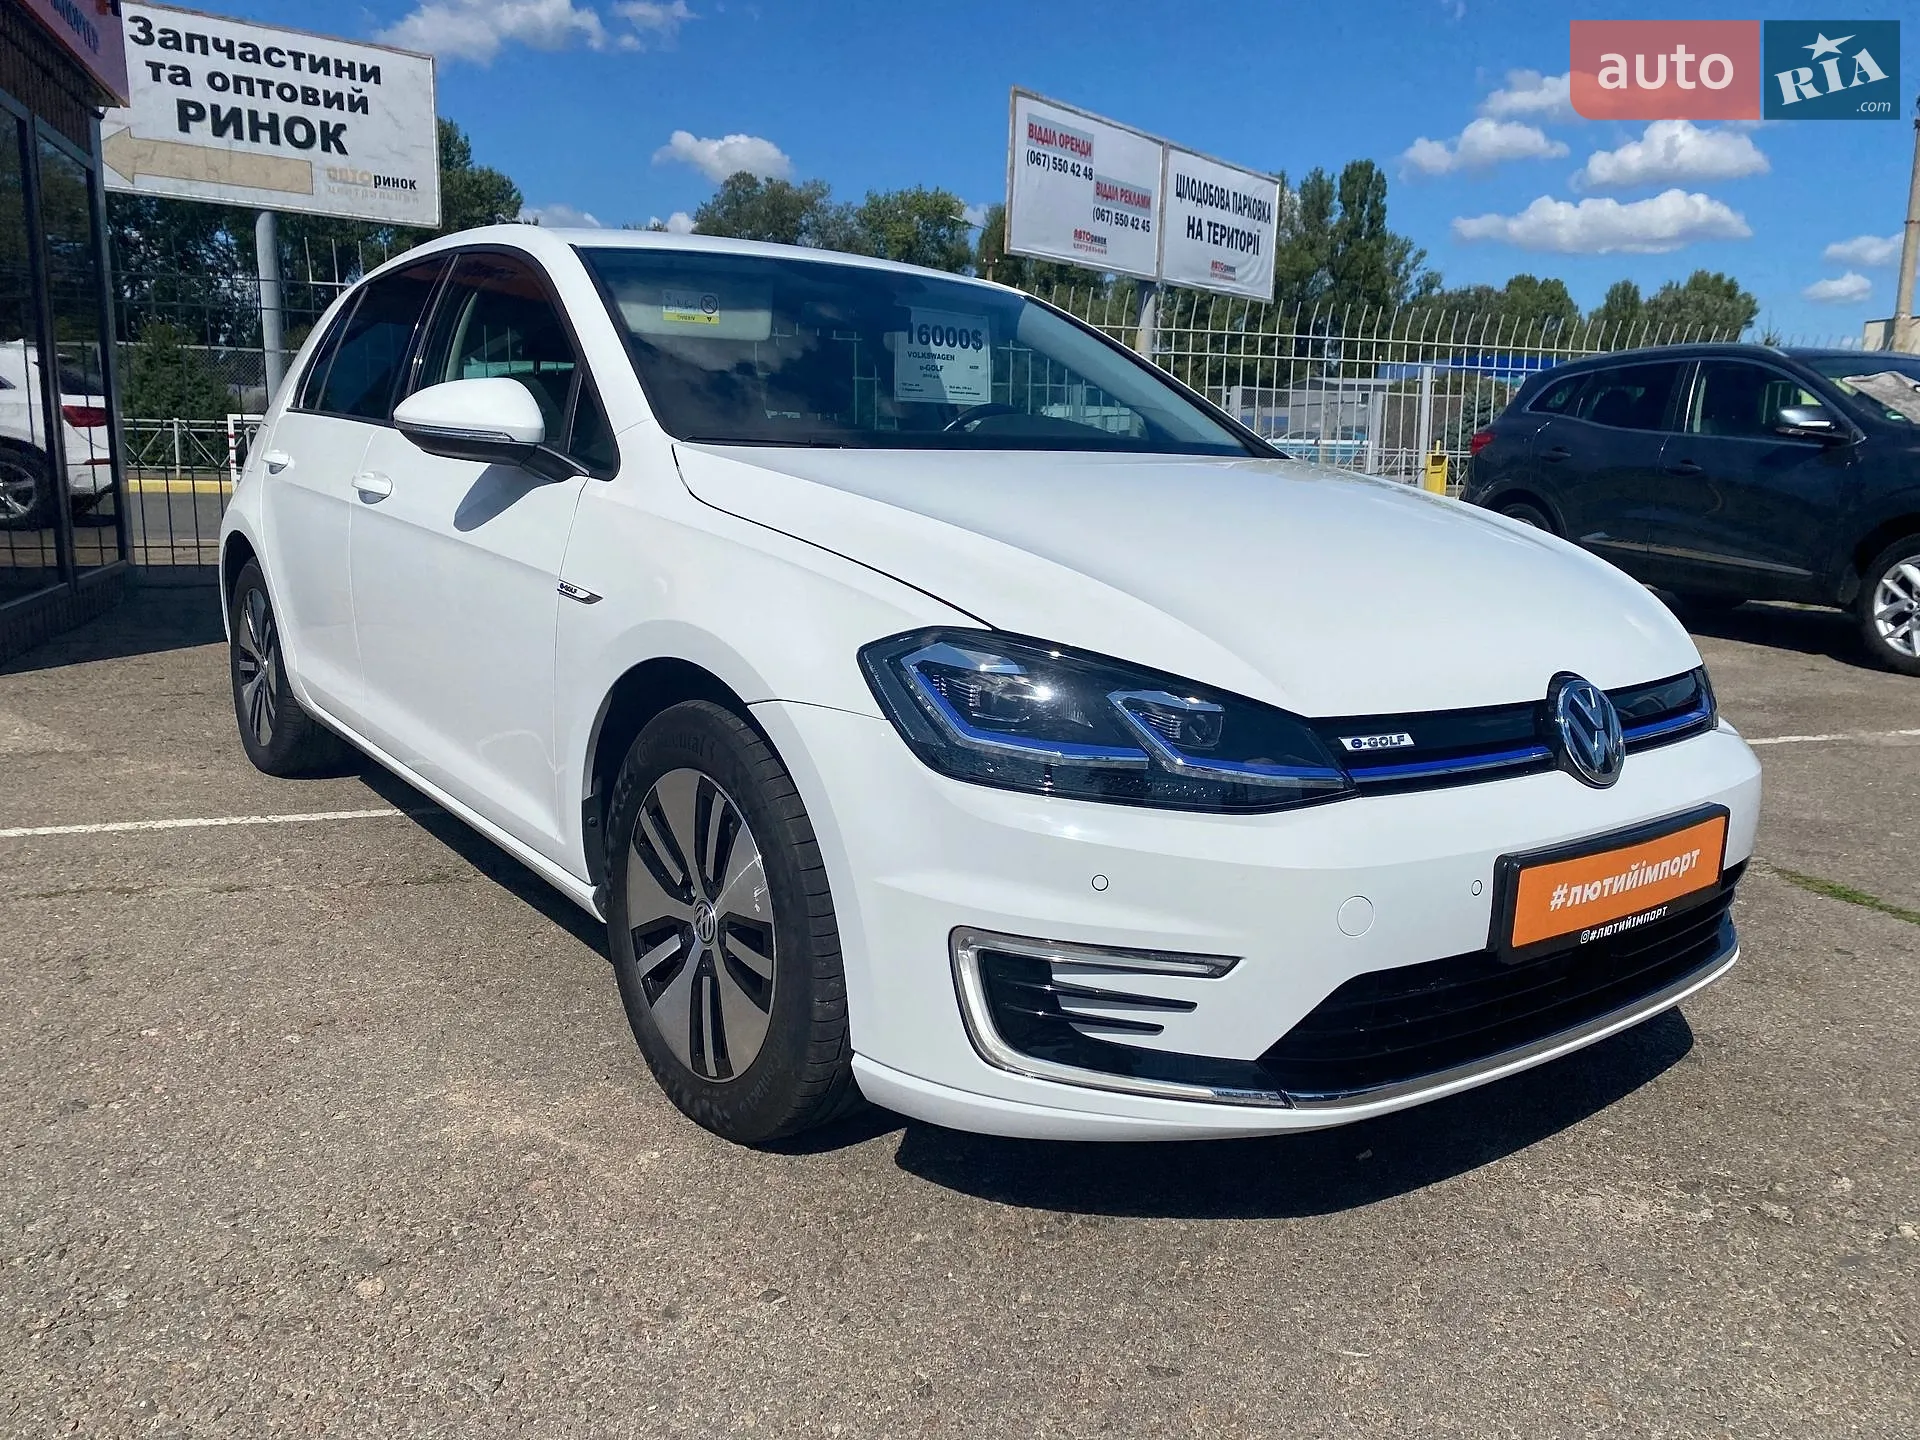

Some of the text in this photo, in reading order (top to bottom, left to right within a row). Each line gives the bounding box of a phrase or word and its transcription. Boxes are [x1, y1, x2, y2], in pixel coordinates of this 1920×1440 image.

[128, 15, 382, 85] Запчастини
[145, 59, 370, 115] та оптовий
[176, 98, 350, 156] РИНОК
[1028, 123, 1092, 157] ВІДДІЛ ОРЕНДИ
[1026, 149, 1093, 181] (067) 550 42 48
[1176, 173, 1271, 224] ЦІЛОДОБОВА ПАРКОВКА
[1092, 206, 1150, 232] (067) 550 42 45
[1186, 215, 1261, 256] НА ТЕРИТОРІЇ
[906, 321, 984, 353] 16000$
[907, 351, 955, 361] VOLKSWAGEN
